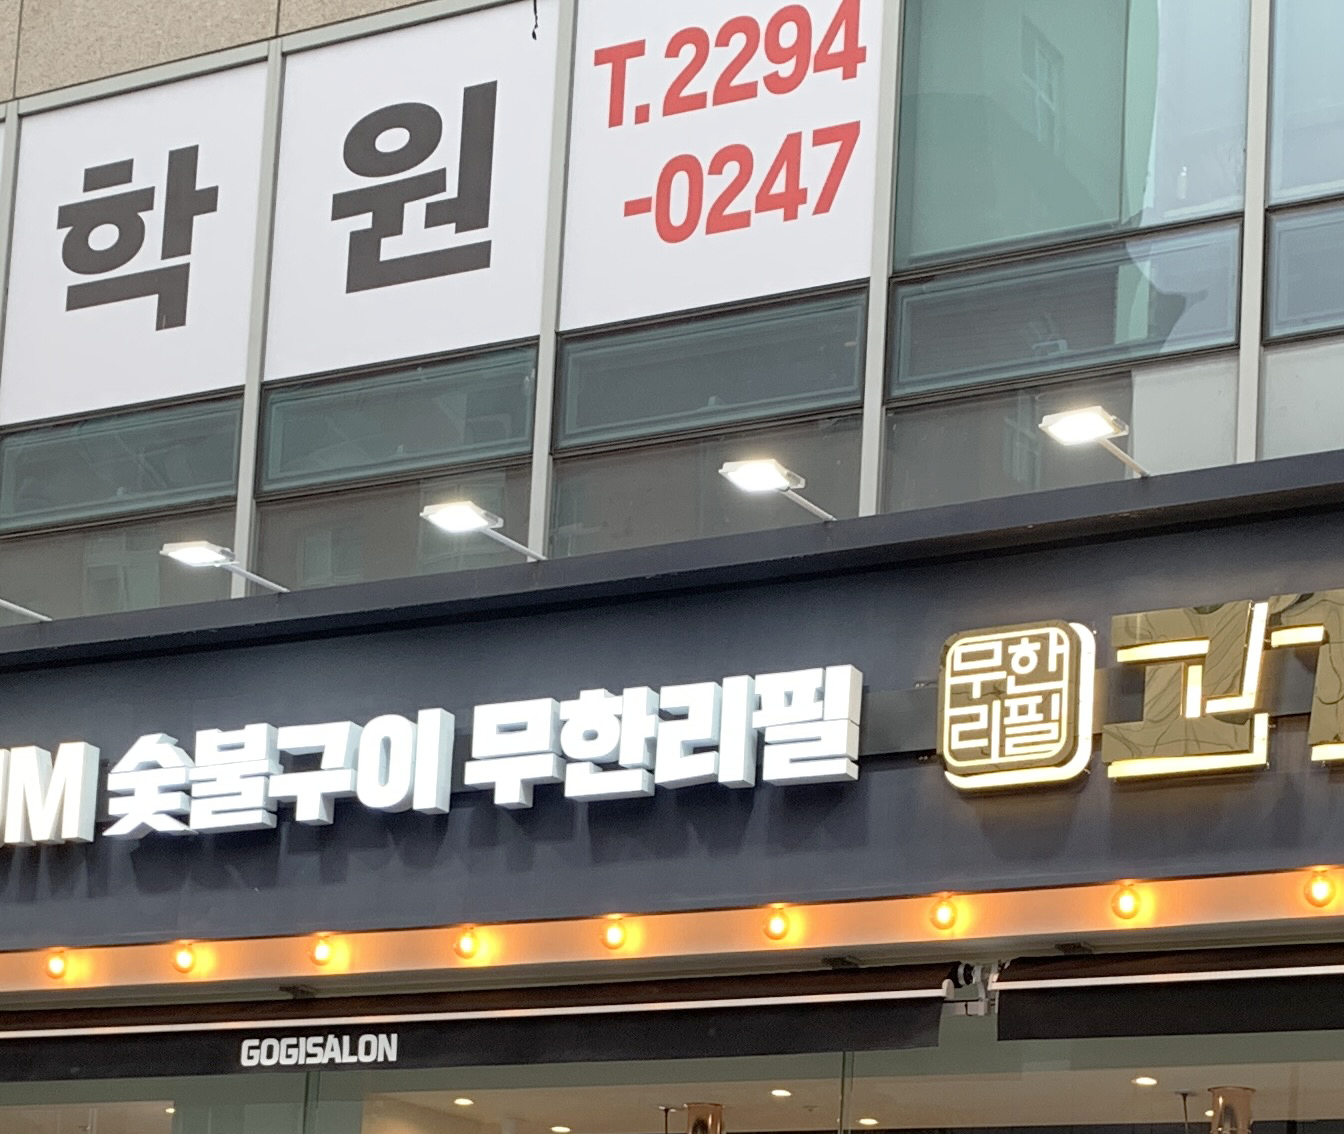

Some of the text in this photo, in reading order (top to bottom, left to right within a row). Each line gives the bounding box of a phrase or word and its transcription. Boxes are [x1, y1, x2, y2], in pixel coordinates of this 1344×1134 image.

[594, 0, 867, 128] T.2294
[624, 120, 861, 244] -0247
[952, 632, 1068, 698] 무한
[102, 708, 455, 837] 숯불구이
[464, 664, 863, 809] 무한리필
[949, 692, 1062, 760] 리필
[240, 1033, 398, 1067] GOGISALON
